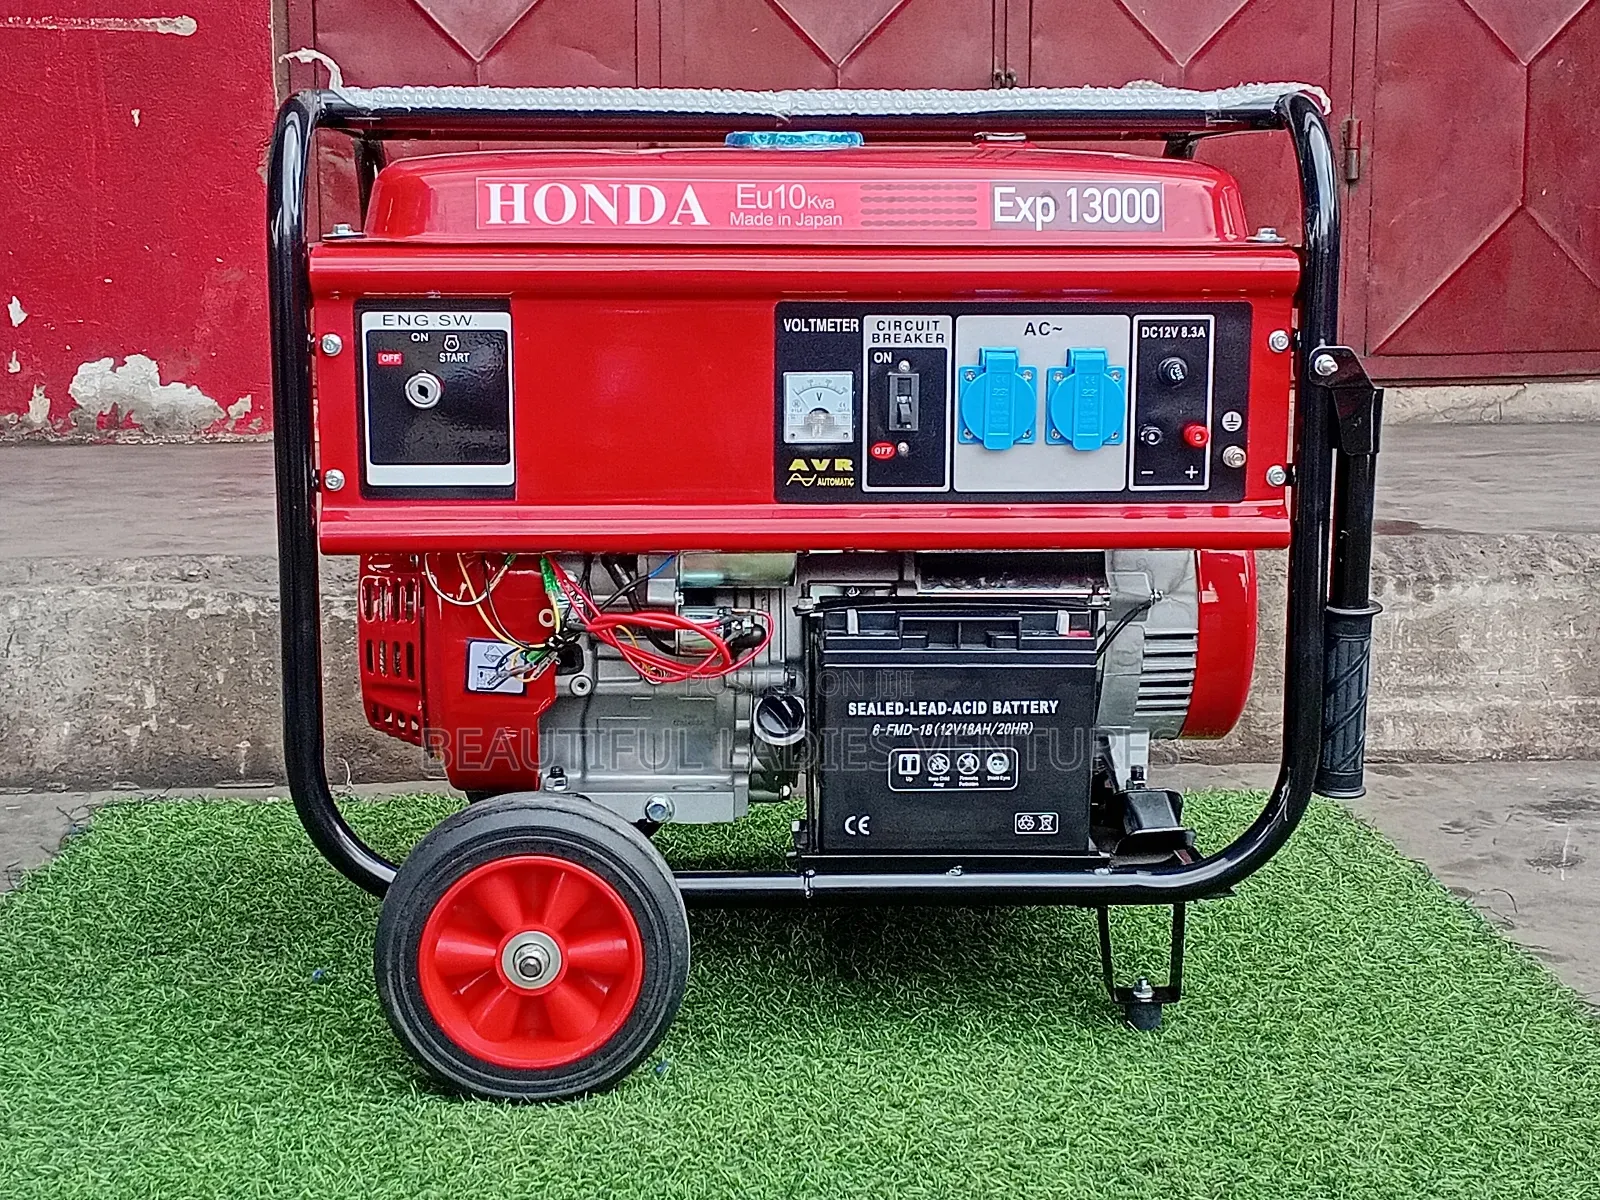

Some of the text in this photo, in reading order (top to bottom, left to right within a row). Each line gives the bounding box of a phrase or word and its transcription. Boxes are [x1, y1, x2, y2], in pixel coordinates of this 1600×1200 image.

[485, 183, 710, 226] HONDA
[994, 186, 1161, 231] Exp 13000
[730, 212, 842, 228] Made in Japan
[784, 318, 859, 333] VOLTMETER
[876, 320, 940, 331] CIRCUIT
[411, 332, 429, 342] ON
[1141, 326, 1206, 338] DC12V 8.3A
[871, 333, 945, 343] BREAKER
[381, 353, 400, 362] OFF
[439, 352, 470, 363] START
[874, 352, 892, 363] ON
[816, 392, 823, 401] V
[874, 447, 893, 455] OFF
[788, 459, 854, 471] AVR
[817, 478, 855, 487] AUTOMATIC
[848, 700, 1059, 716] SEALED-LEAD-ACID BATTERY
[844, 815, 871, 835] CE
